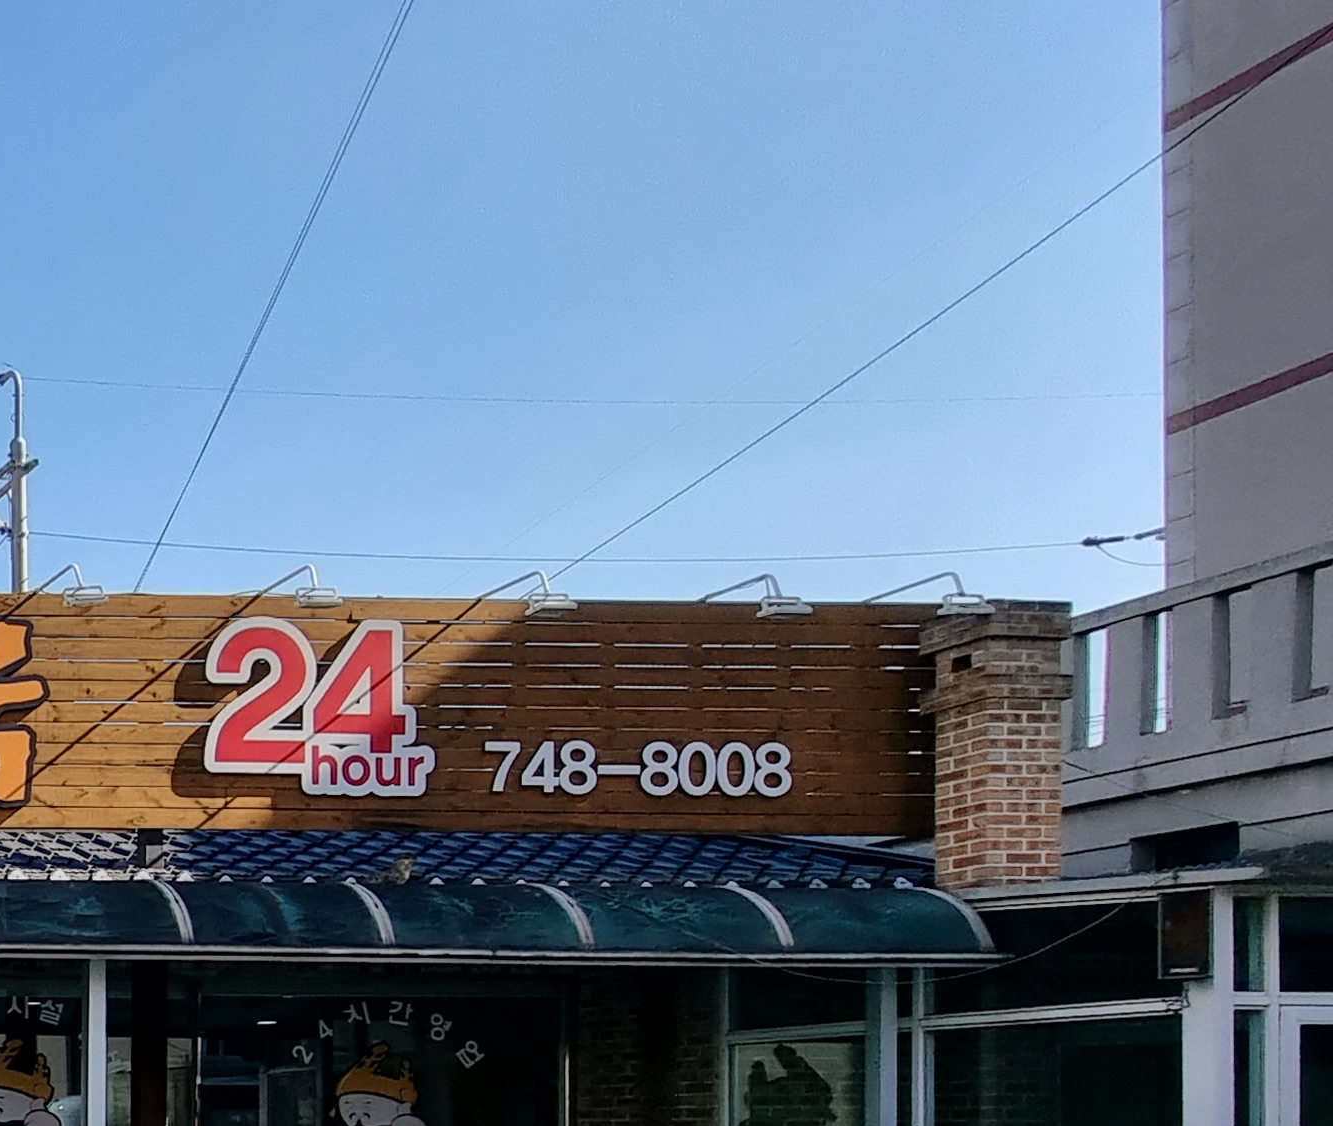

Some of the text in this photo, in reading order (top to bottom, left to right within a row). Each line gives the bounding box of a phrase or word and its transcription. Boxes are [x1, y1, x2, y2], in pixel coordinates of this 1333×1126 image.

[207, 619, 413, 770] 24
[307, 744, 429, 789] hour
[484, 740, 792, 797] 748-8008
[7, 995, 64, 1026] 시설
